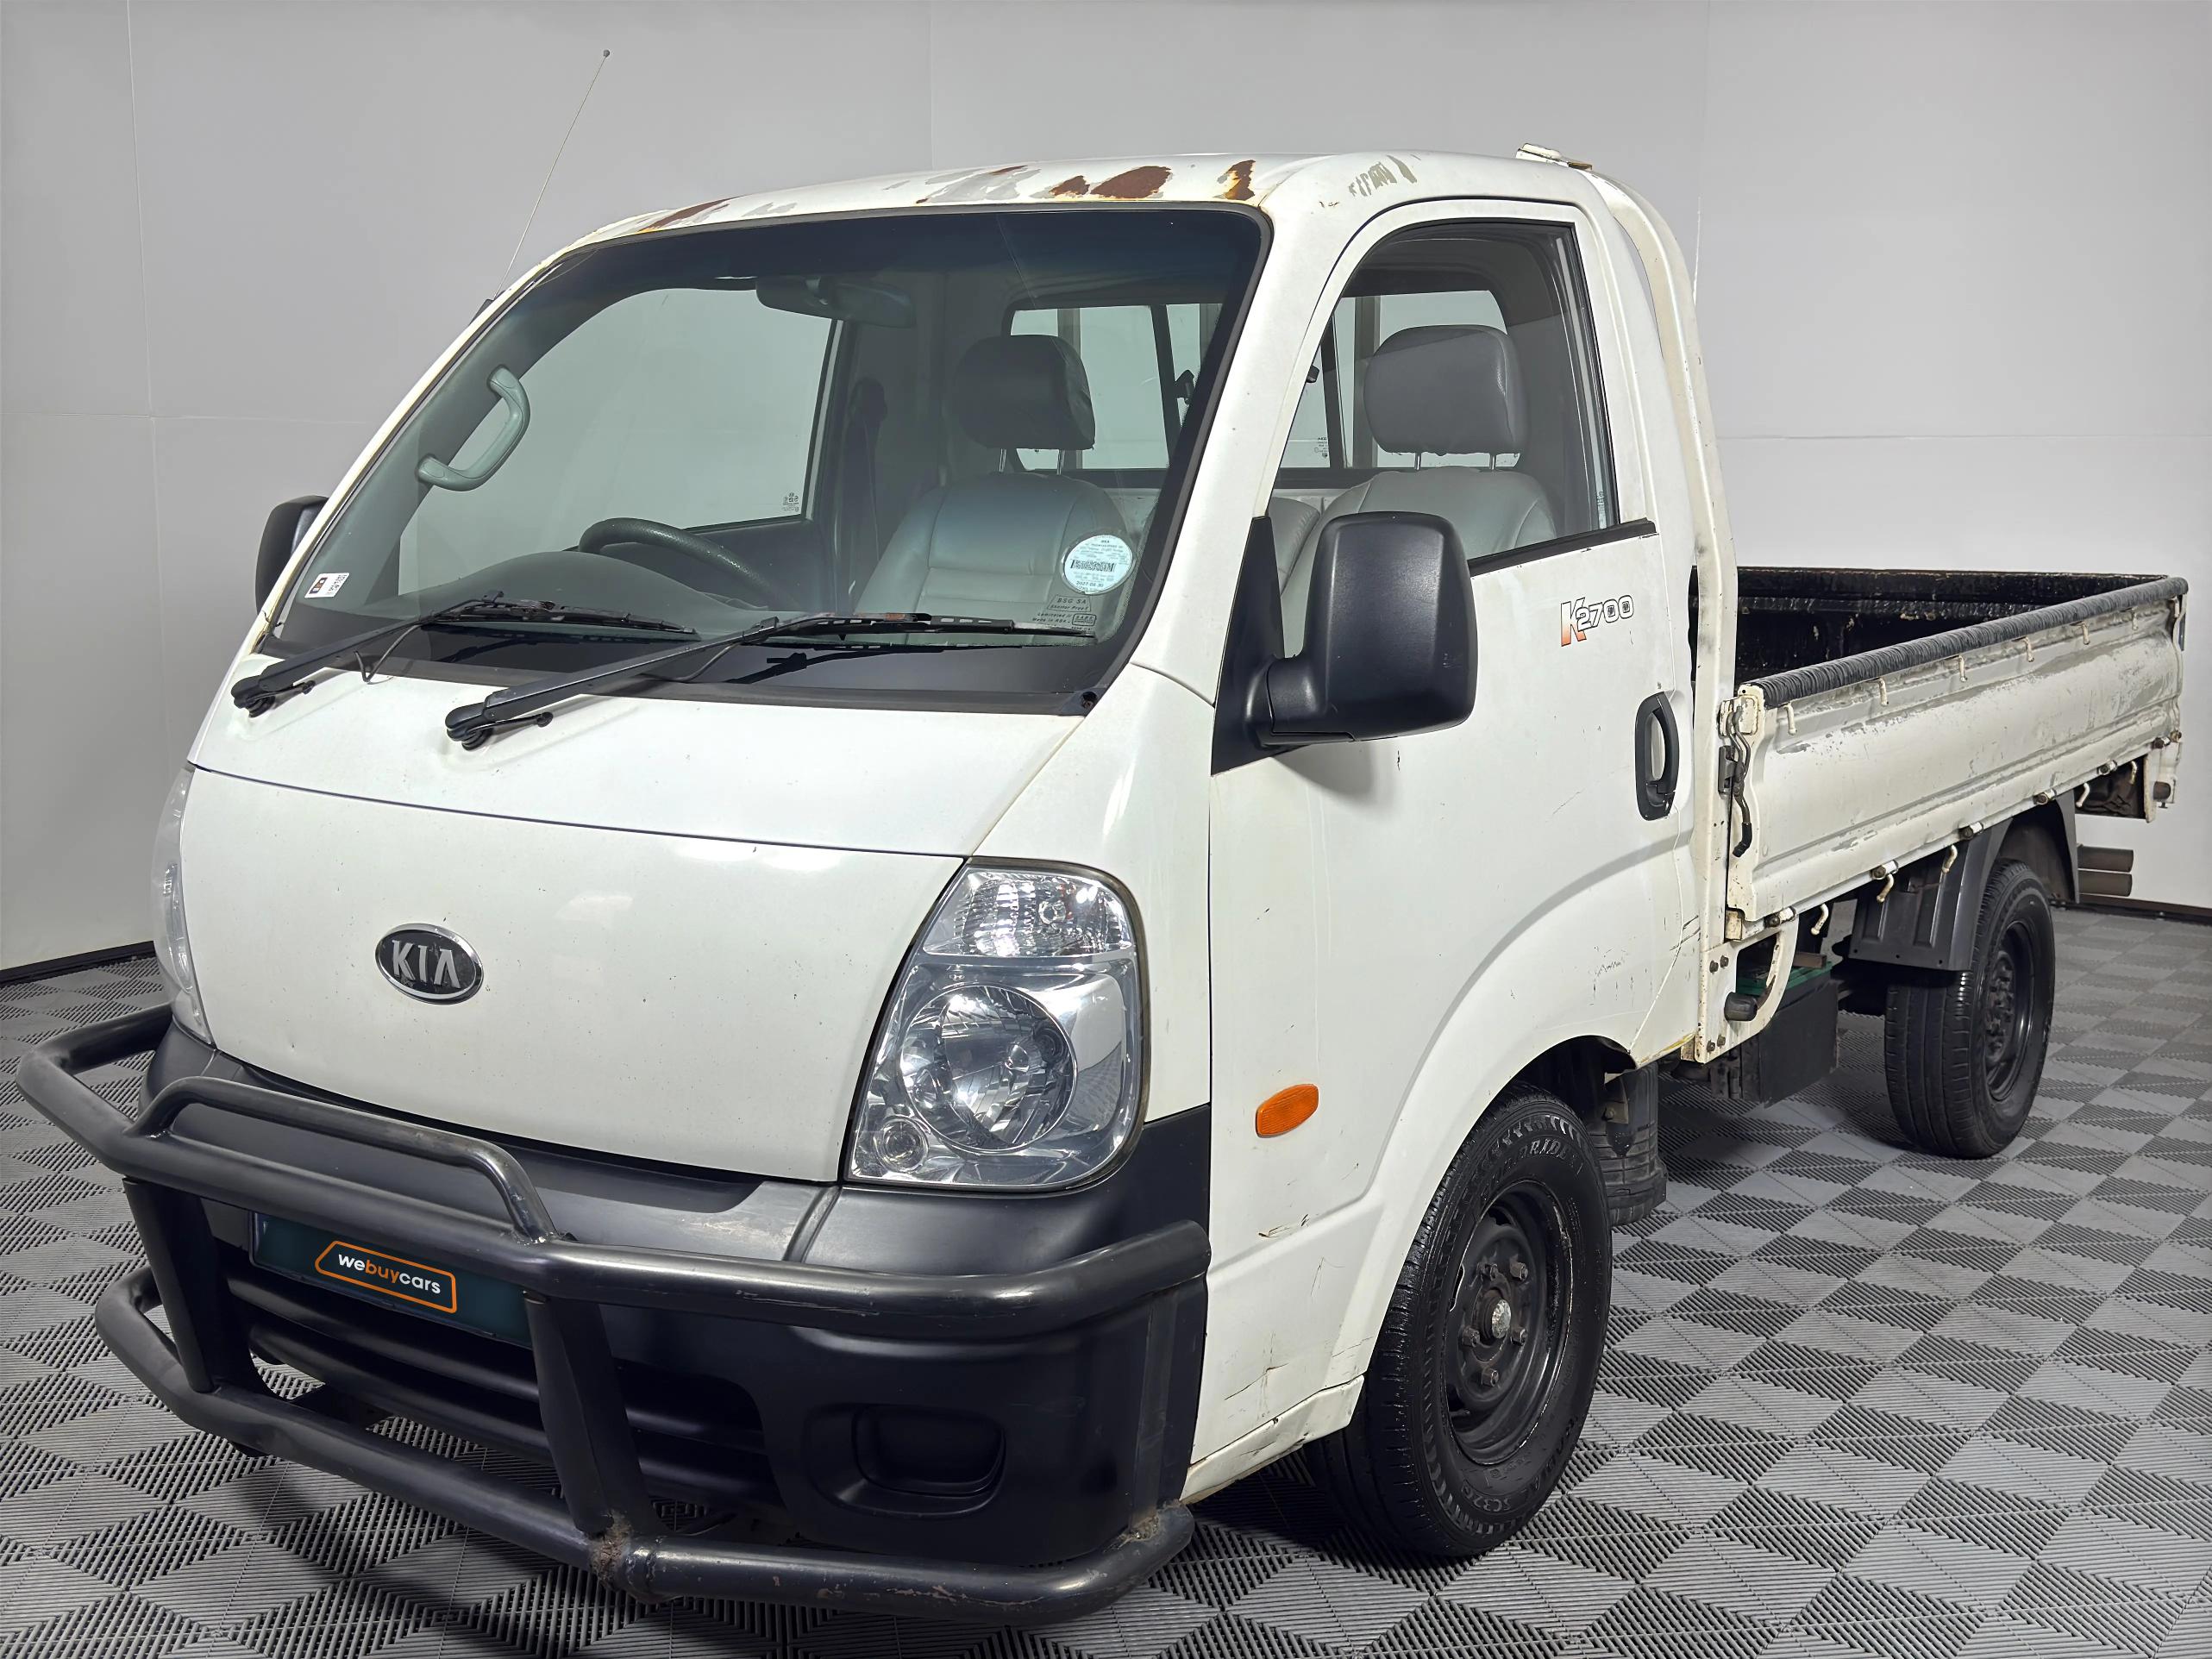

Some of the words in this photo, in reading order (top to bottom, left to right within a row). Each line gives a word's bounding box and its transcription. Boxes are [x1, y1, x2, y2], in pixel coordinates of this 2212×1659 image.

[1560, 595, 1634, 647] K2700
[392, 939, 461, 989] KIA
[338, 1254, 441, 1294] webuycars
